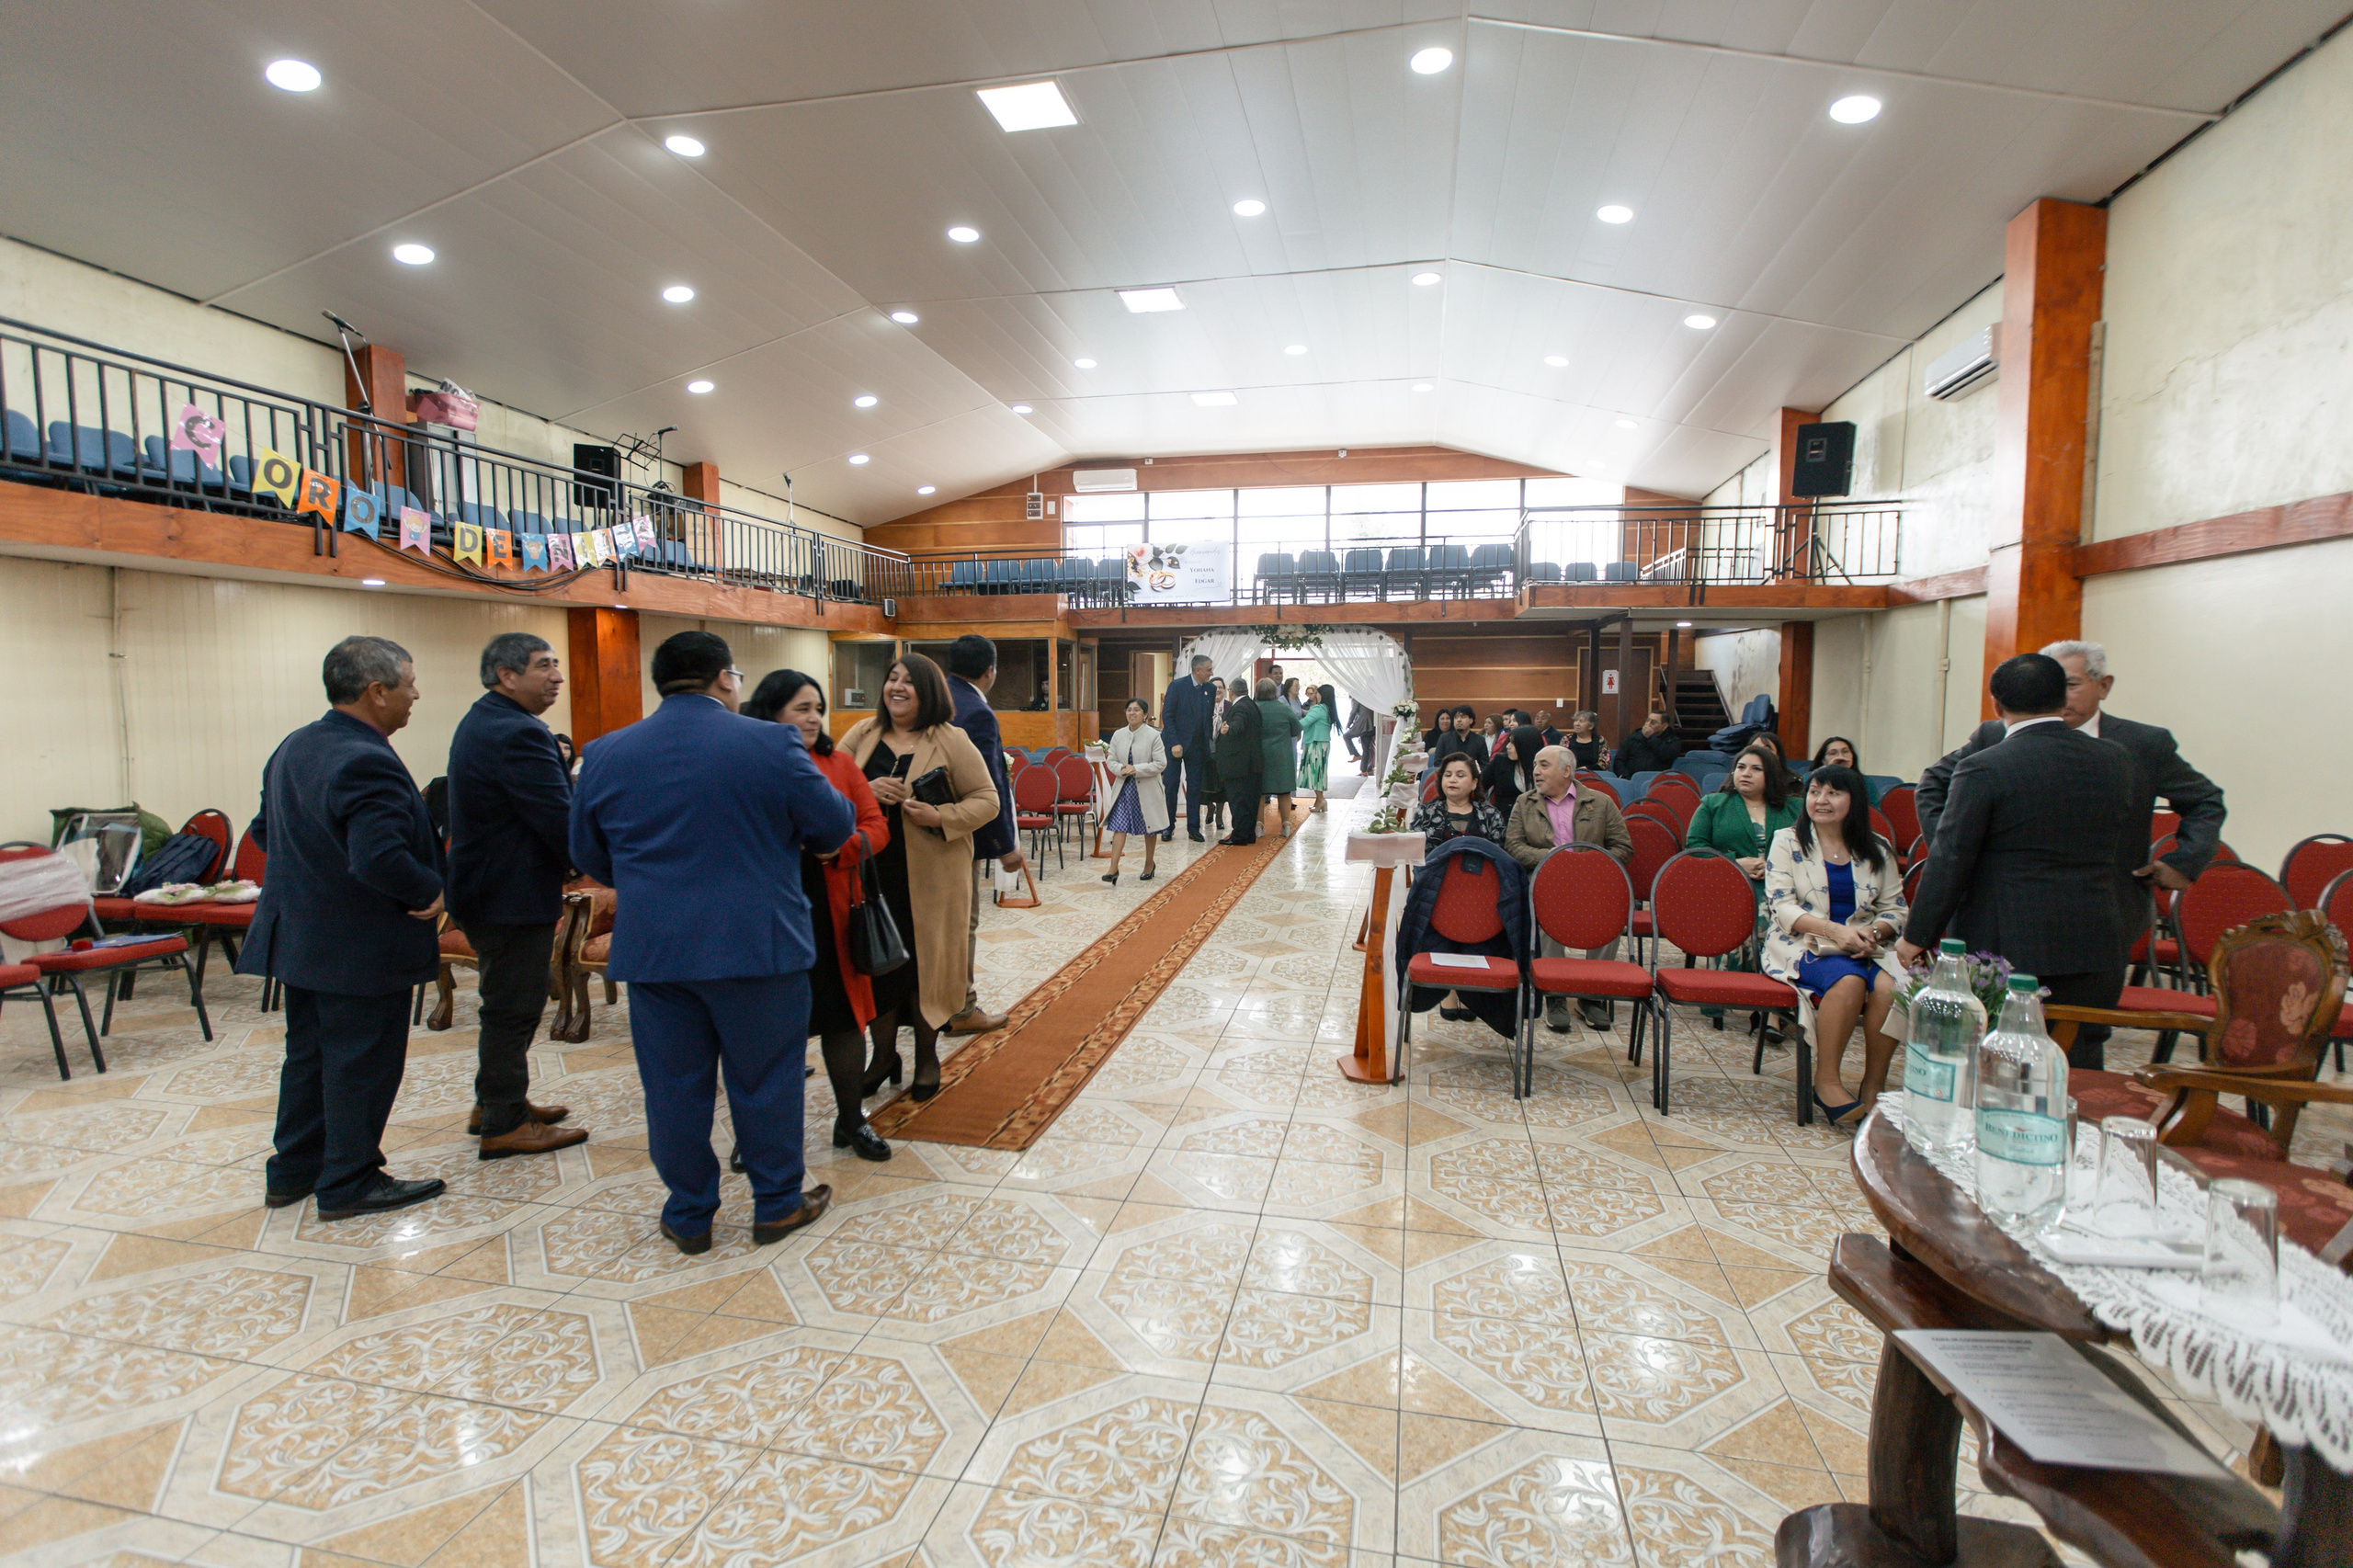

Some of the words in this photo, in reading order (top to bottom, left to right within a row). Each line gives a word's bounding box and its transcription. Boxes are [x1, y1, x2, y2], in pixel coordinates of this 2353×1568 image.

[185, 415, 376, 525] CORO
[460, 527, 505, 558] DE
[1985, 1122, 2058, 1142] BENEDICTINO
